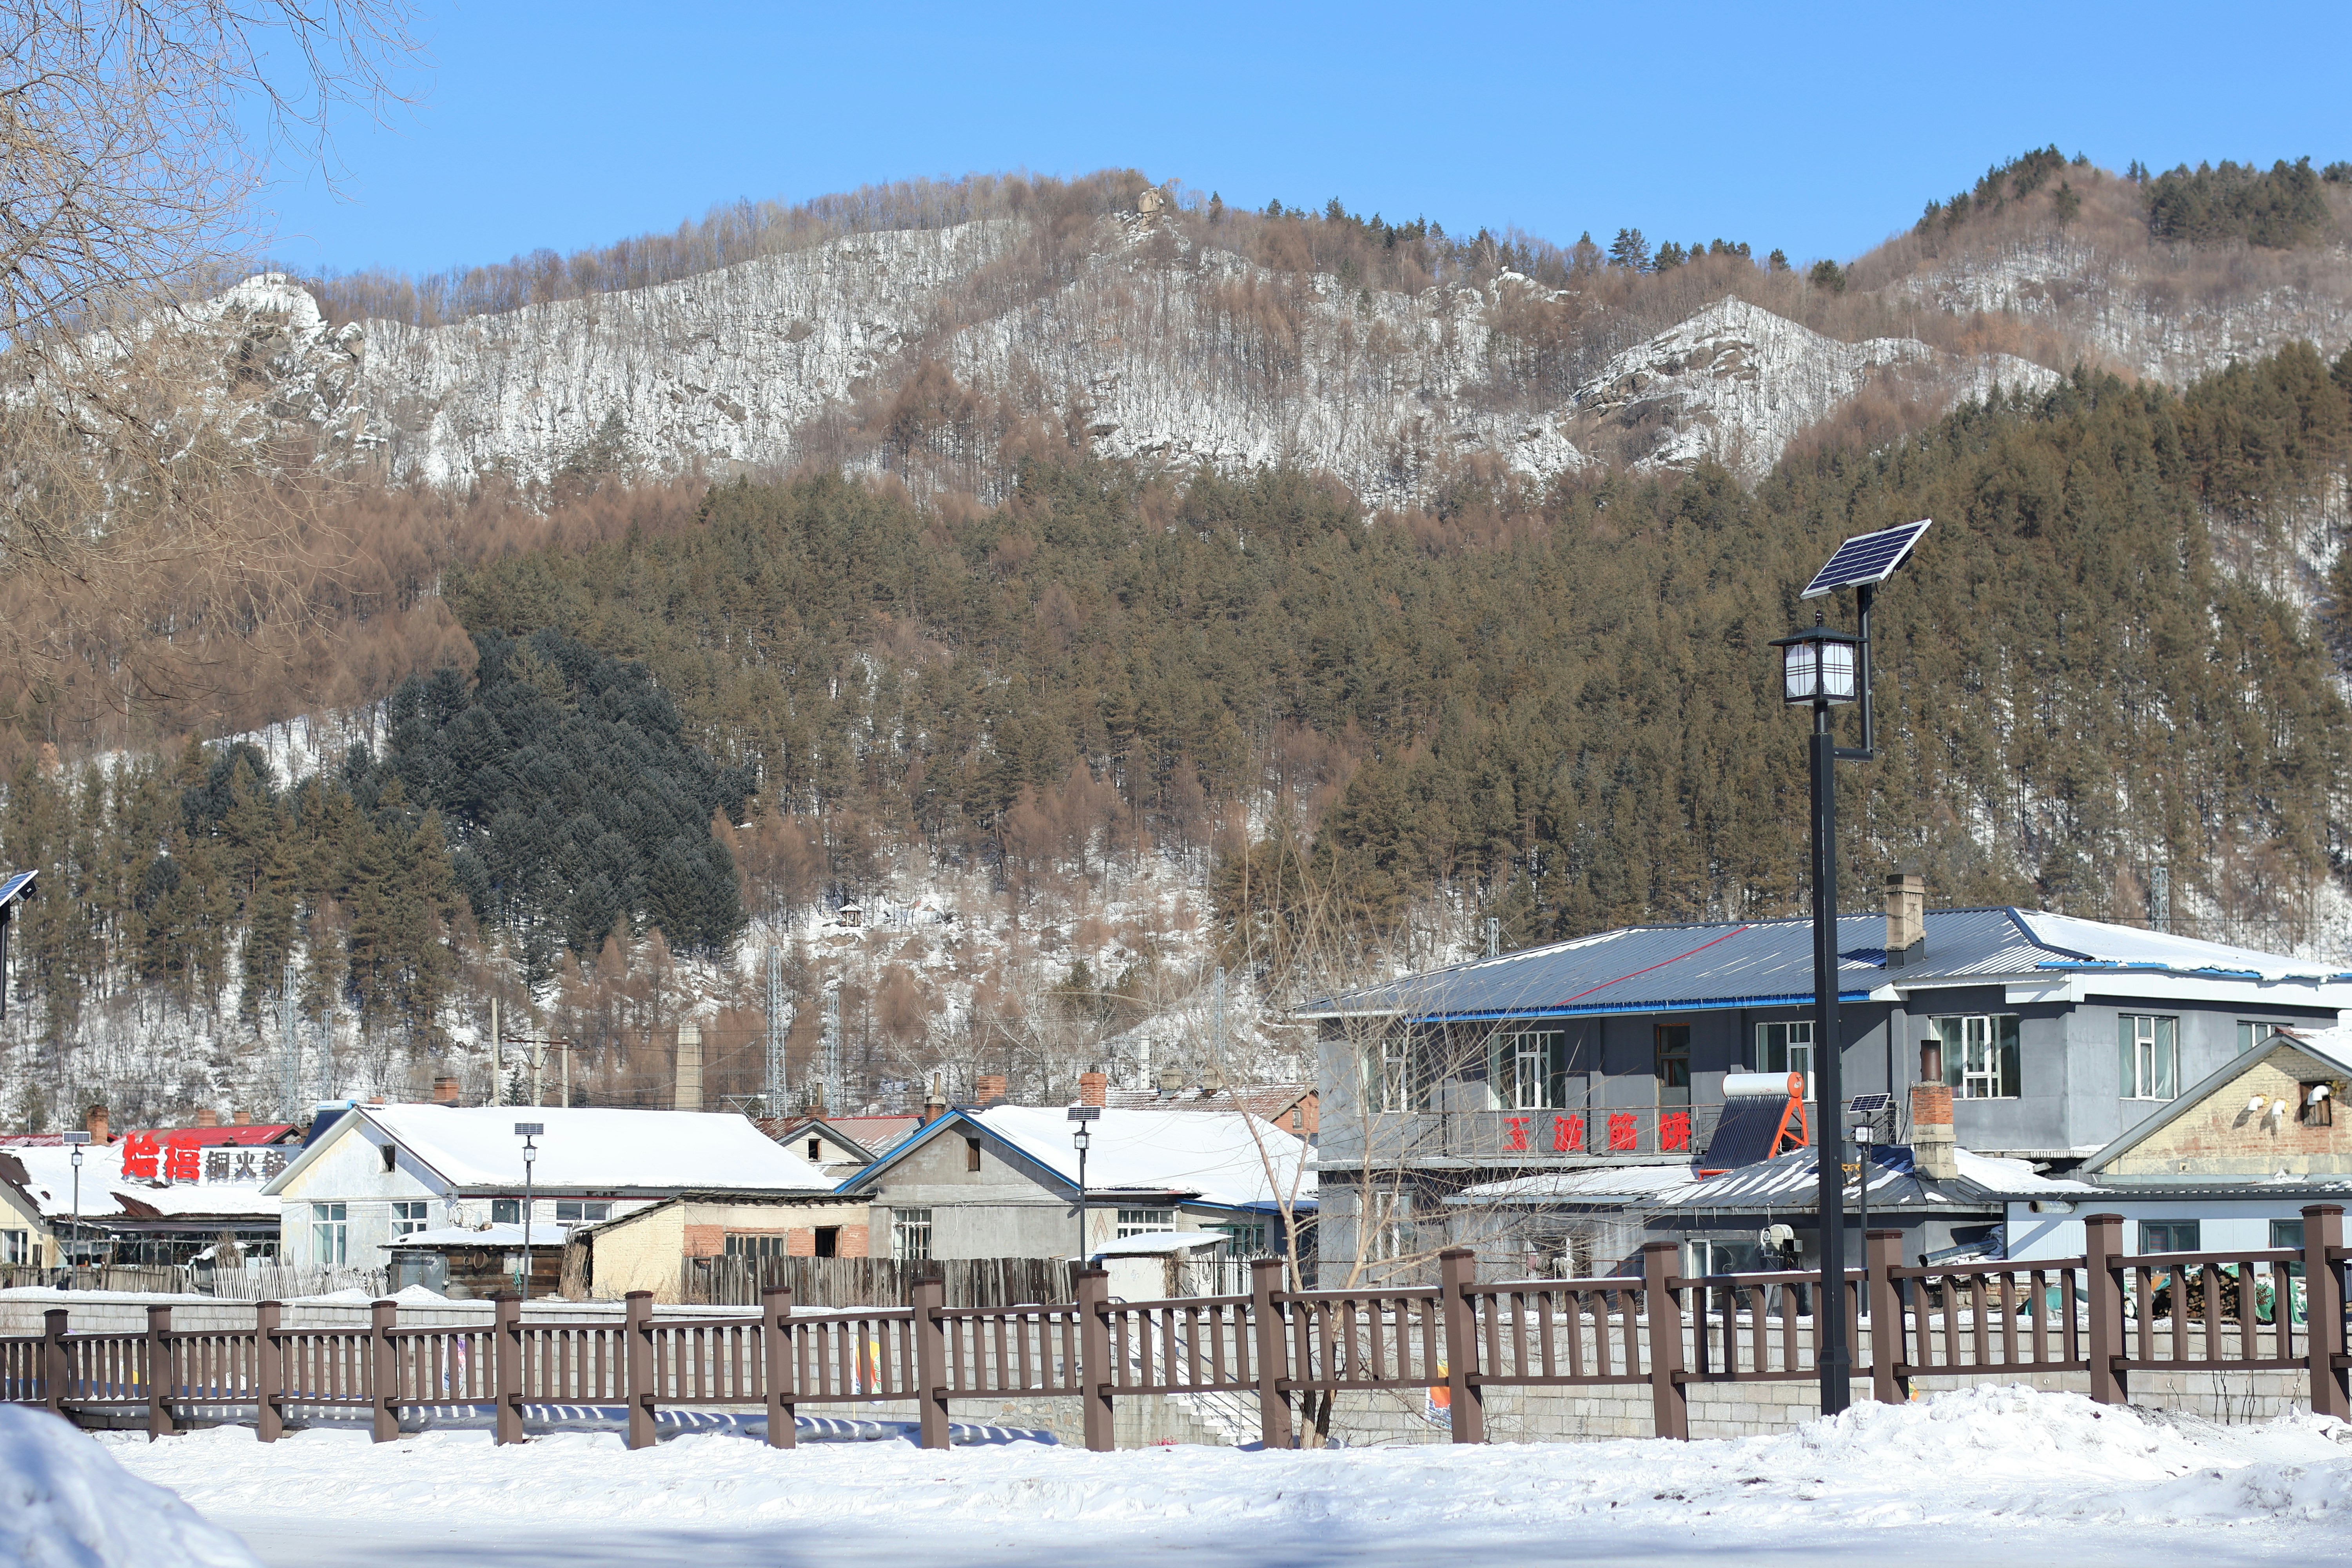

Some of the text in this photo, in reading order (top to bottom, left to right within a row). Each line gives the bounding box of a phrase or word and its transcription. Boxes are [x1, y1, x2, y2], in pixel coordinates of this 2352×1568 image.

[1503, 1111, 1691, 1151] 玉波筋饼
[206, 1151, 286, 1179] 铜火锅
